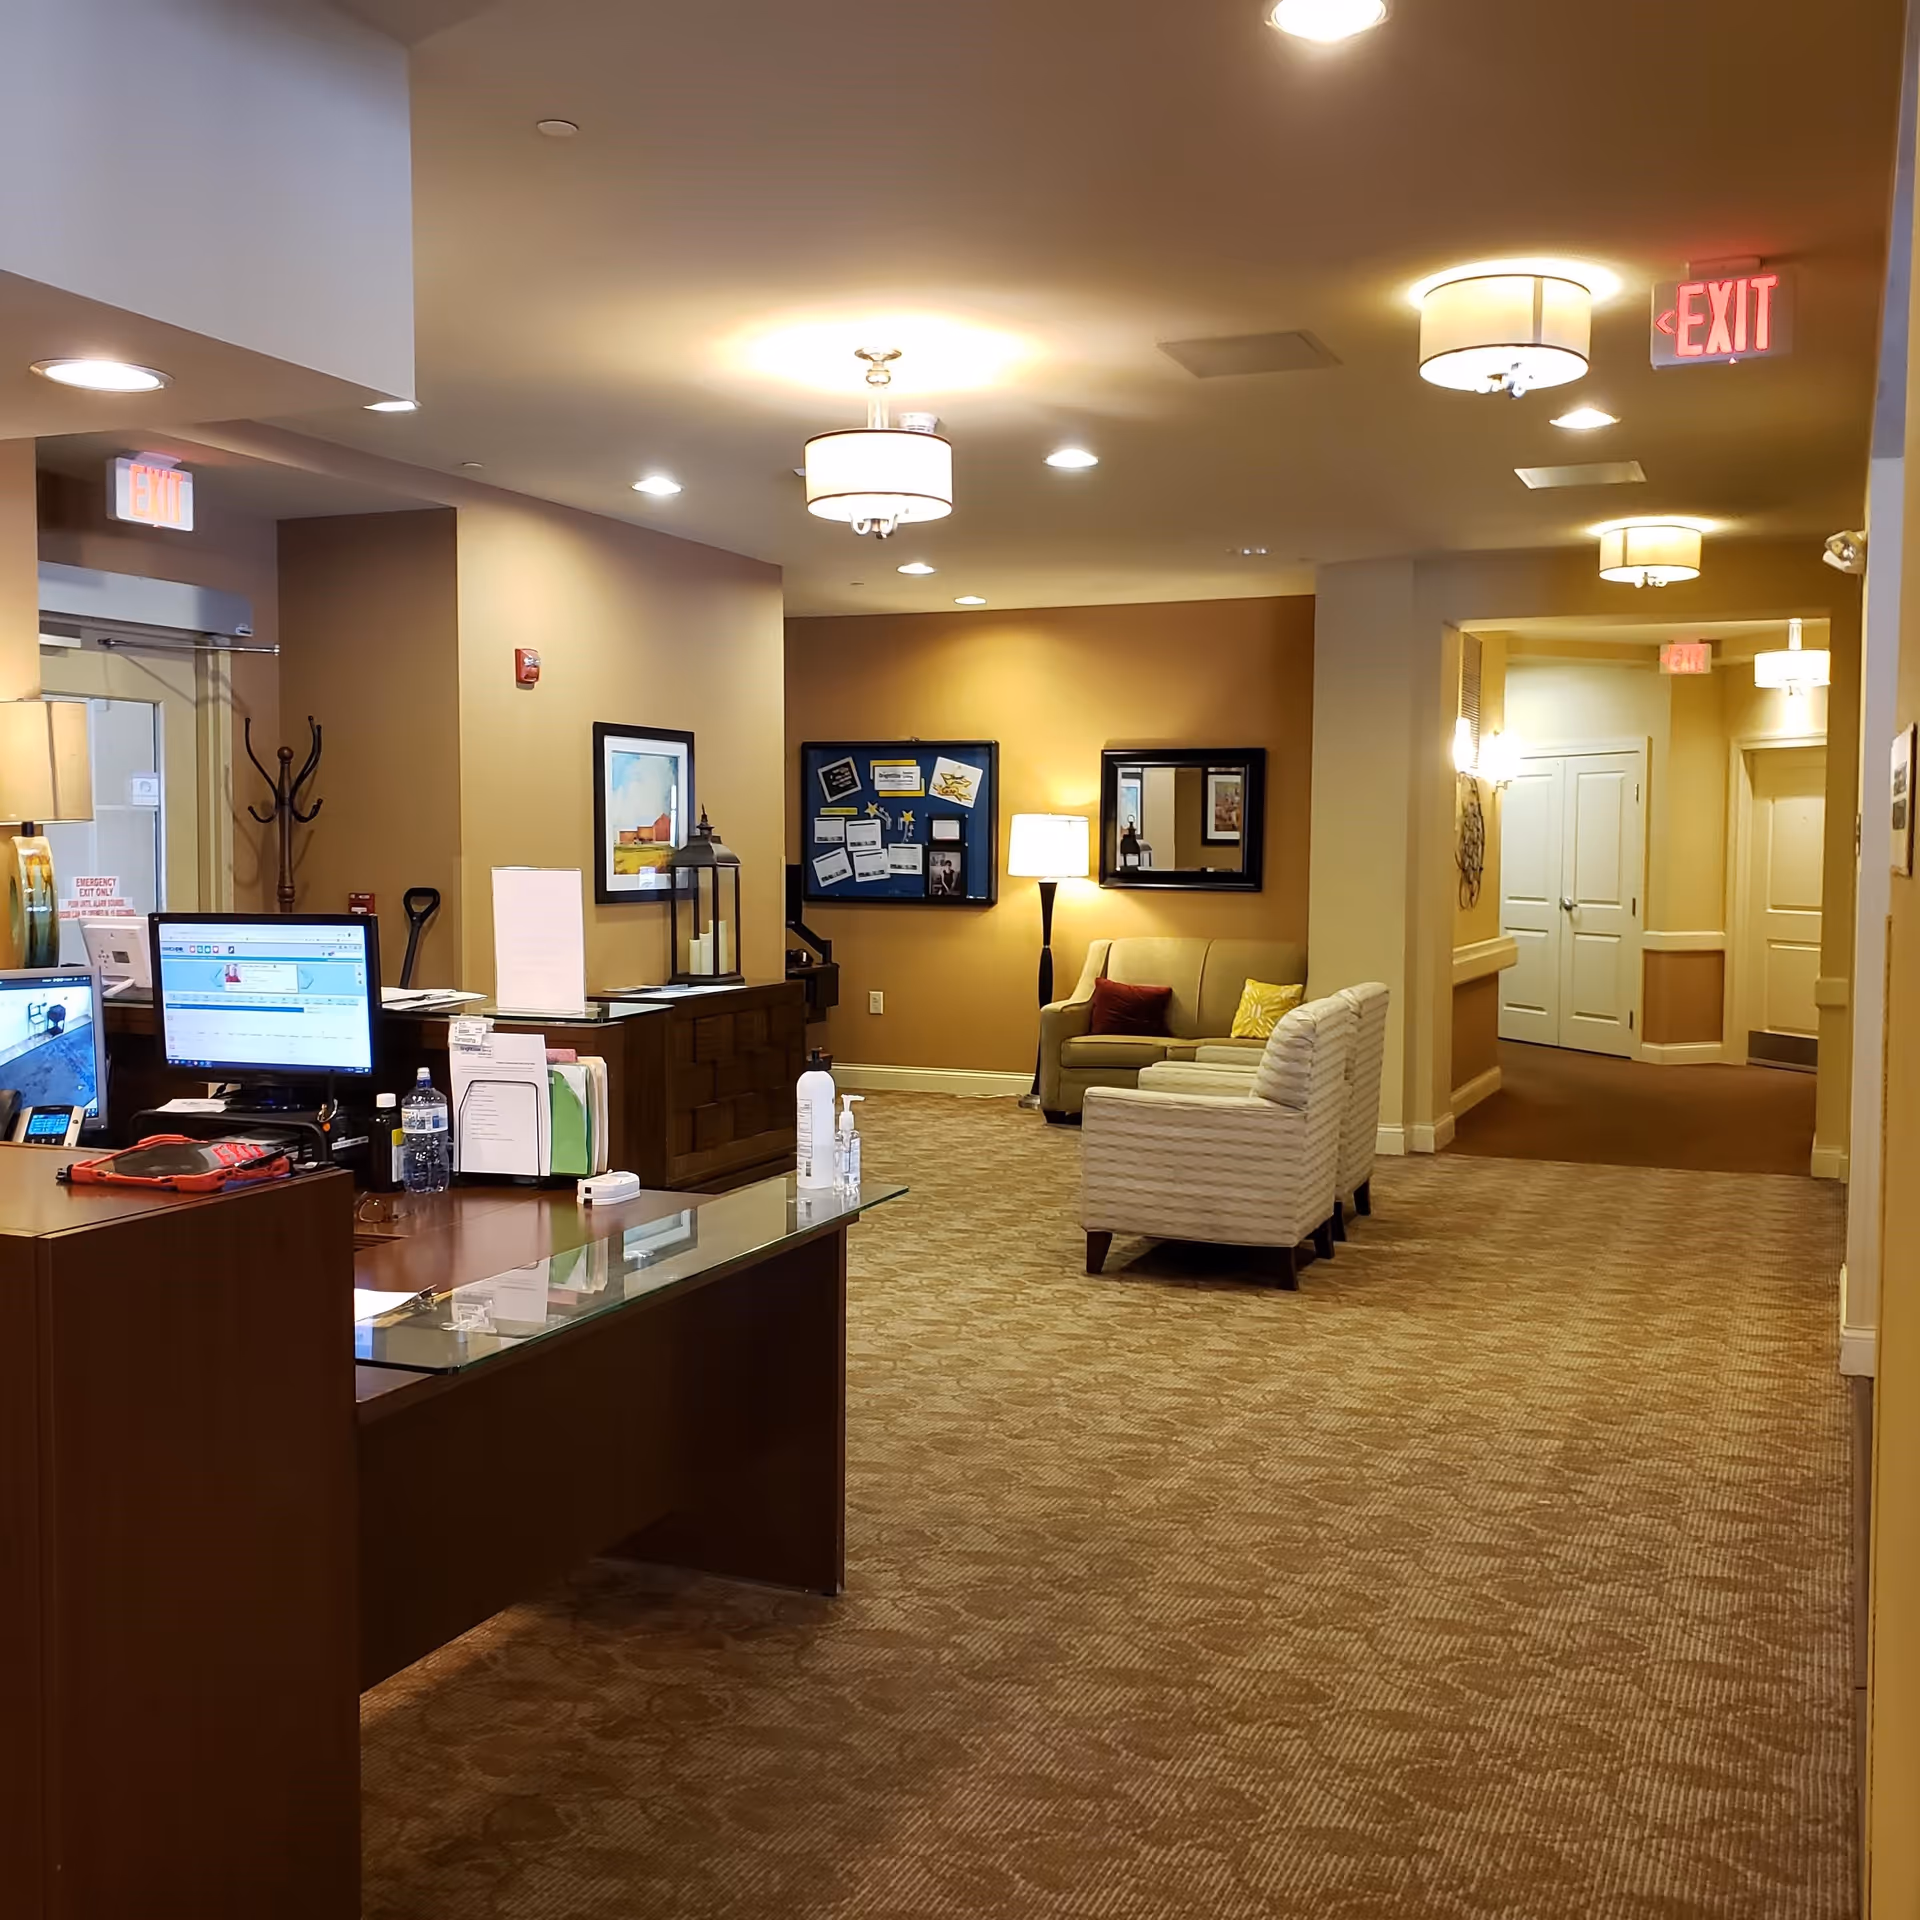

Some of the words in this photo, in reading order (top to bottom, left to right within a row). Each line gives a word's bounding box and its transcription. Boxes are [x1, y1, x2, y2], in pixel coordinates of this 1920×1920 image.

[1676, 274, 1778, 357] EXIT
[129, 464, 183, 523] EXIT
[76, 878, 116, 887] EMERGENCY
[79, 888, 94, 897] EXIT
[96, 888, 114, 897] ONLY
